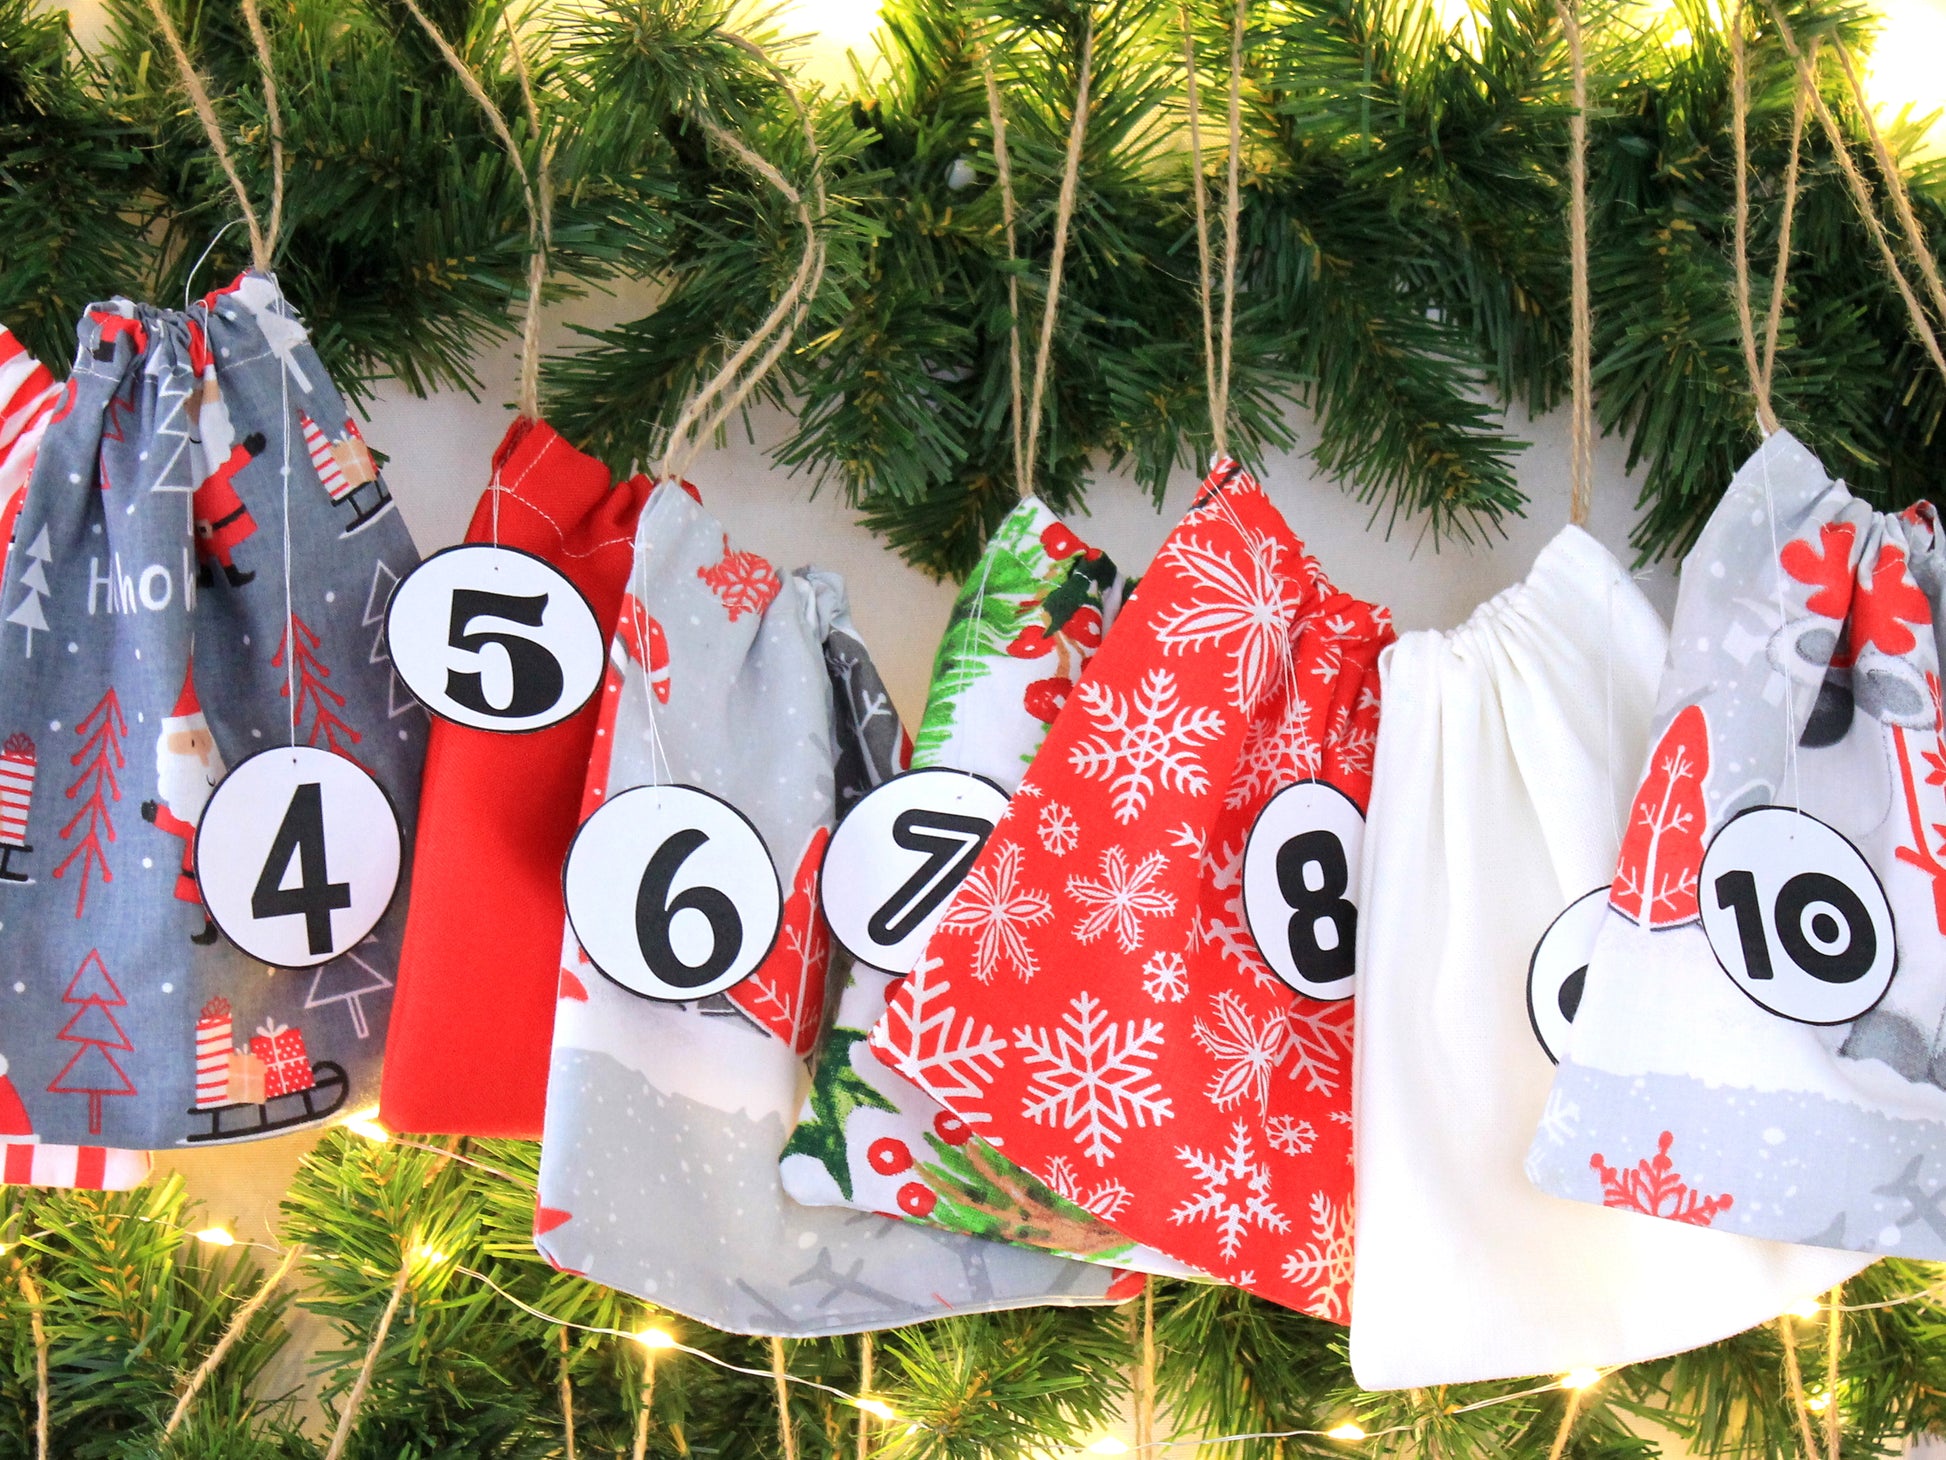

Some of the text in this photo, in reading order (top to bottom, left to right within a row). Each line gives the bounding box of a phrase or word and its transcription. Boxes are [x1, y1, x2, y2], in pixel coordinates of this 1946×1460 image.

[444, 588, 564, 718] 5
[251, 782, 351, 956] 4
[635, 828, 743, 989] 6
[867, 808, 995, 946] 7
[1275, 829, 1358, 984] 8
[1714, 870, 1877, 984] 10
